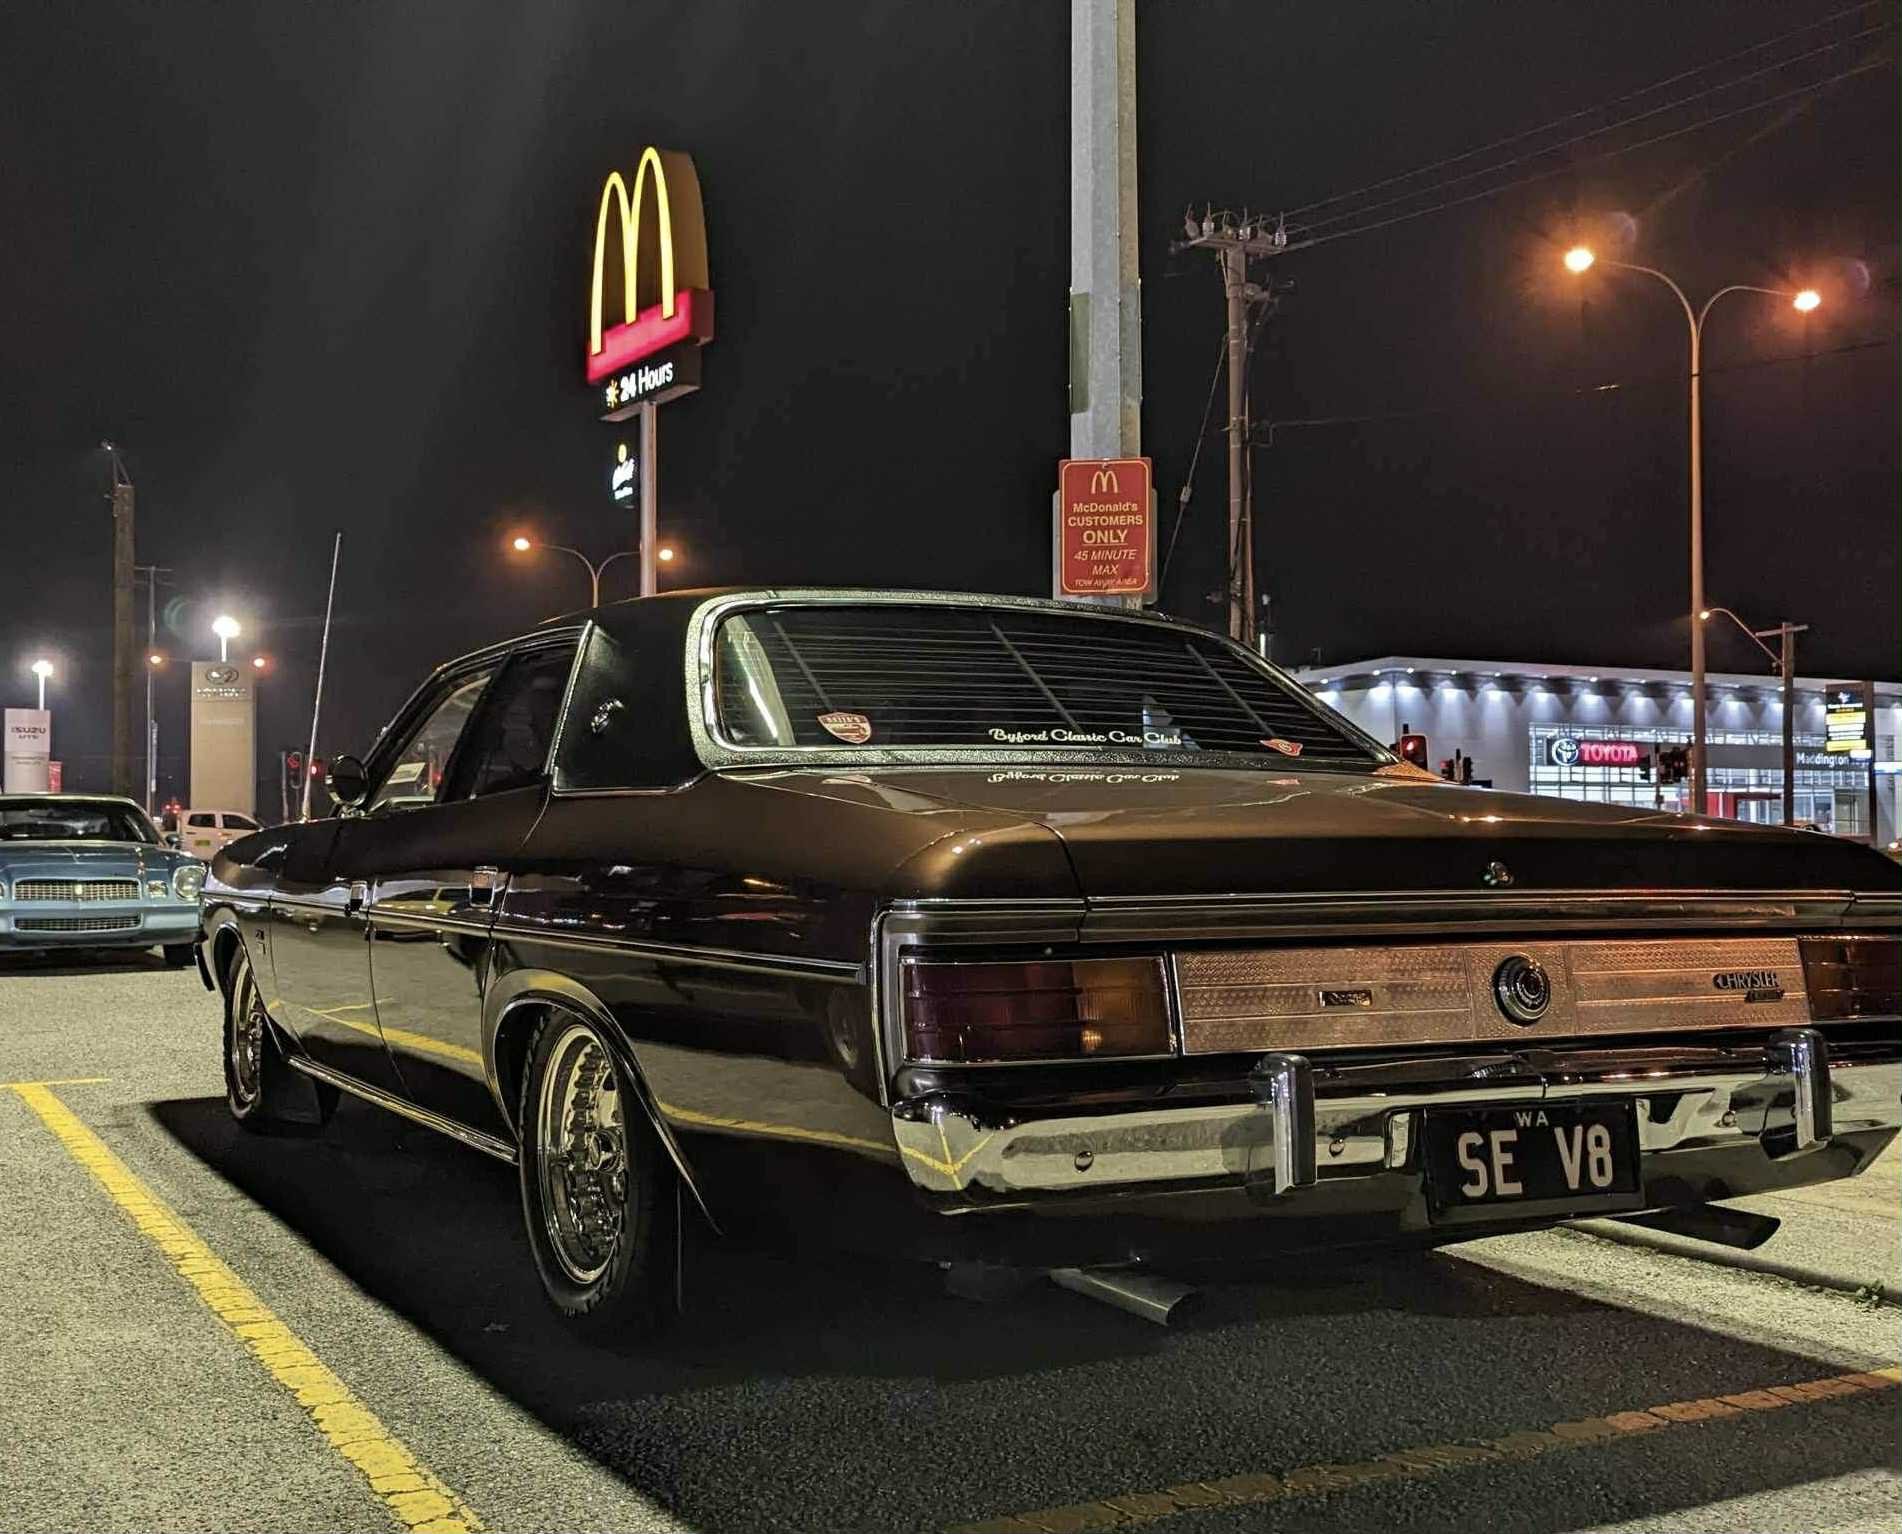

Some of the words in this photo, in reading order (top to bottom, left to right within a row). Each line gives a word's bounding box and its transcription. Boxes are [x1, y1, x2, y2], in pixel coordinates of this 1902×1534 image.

[620, 372, 637, 402] 24
[638, 362, 673, 394] Hours
[1072, 502, 1138, 513] McDonald's
[1068, 515, 1143, 527] CUSTOMERS
[1083, 530, 1128, 544] ONLY
[1074, 551, 1088, 561] 45
[1091, 549, 1138, 561] MINUTE
[1092, 564, 1120, 575] MAX
[988, 728, 1048, 743] Byford
[1050, 728, 1107, 742] Classic
[1109, 730, 1142, 743] Car
[1144, 732, 1182, 744] Club
[1580, 743, 1638, 761] TOYOTA
[1714, 971, 1777, 988] CHRYSLER
[1515, 1110, 1549, 1127] WA
[1457, 1129, 1523, 1198] SE
[1554, 1123, 1613, 1190] V8
